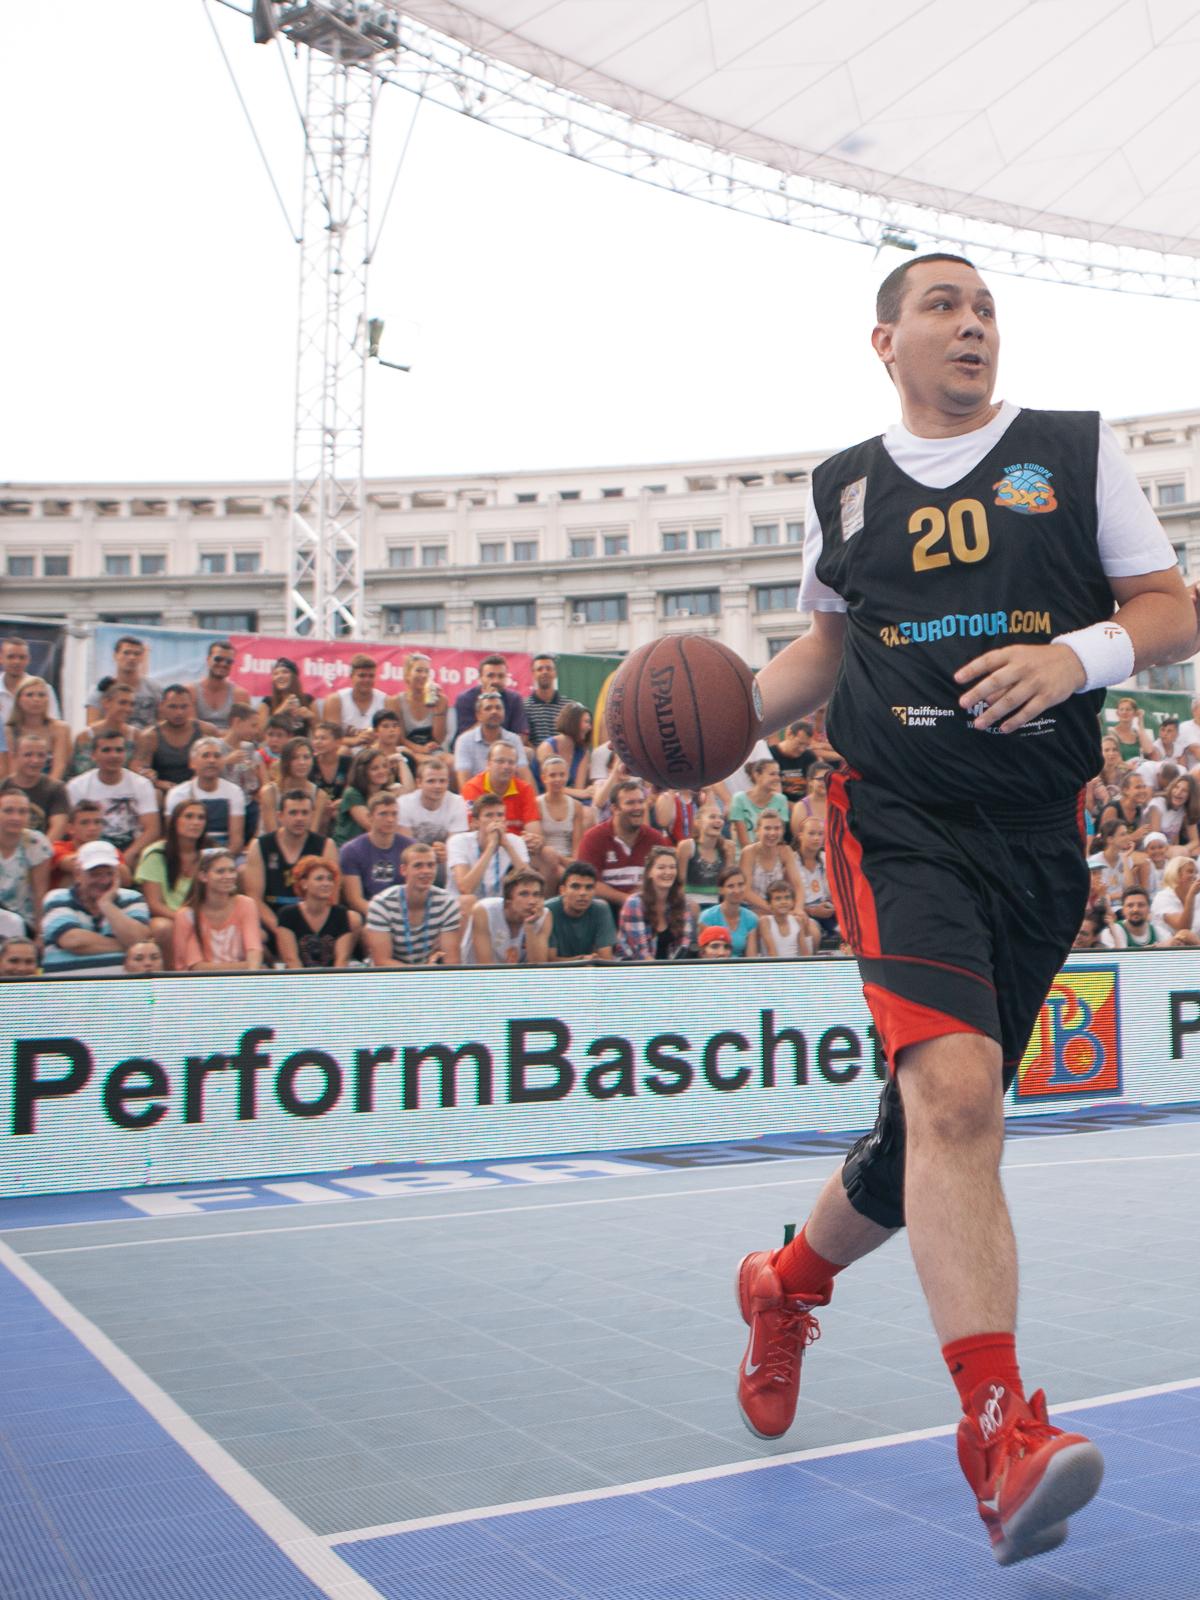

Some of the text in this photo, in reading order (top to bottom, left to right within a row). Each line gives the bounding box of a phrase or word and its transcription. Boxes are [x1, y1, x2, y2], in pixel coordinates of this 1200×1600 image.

[1004, 463, 1053, 479] FIBA EUROPE
[908, 498, 990, 573] 20
[439, 666, 461, 684] to
[650, 665, 693, 774] SPALDING
[908, 706, 955, 716] Raiffeisen
[908, 717, 937, 726] BANK
[121, 1159, 643, 1217] FIBA
